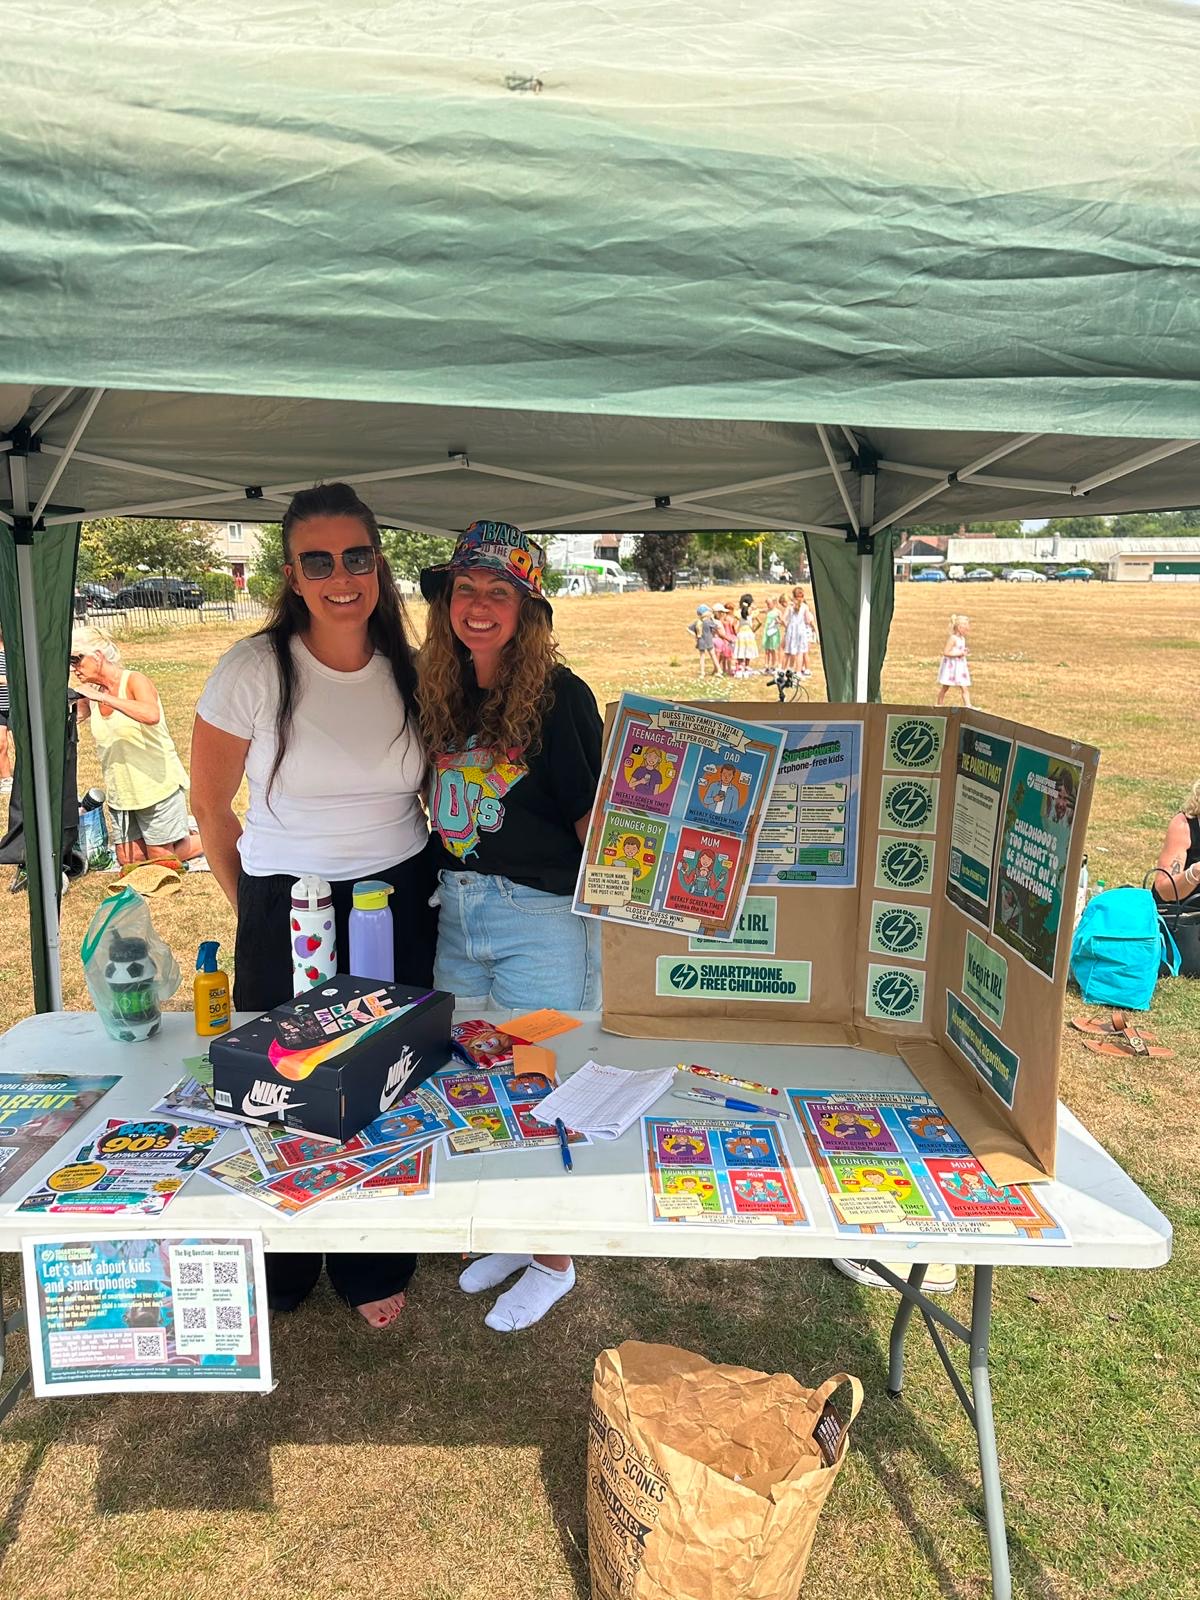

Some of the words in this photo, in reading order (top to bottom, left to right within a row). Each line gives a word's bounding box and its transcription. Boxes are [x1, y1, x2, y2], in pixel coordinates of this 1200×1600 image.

[483, 522, 530, 551] BACK
[493, 544, 508, 557] THE
[662, 711, 680, 720] GUESS
[682, 713, 696, 722] THIS
[696, 716, 722, 730] FAMILY'S
[723, 723, 740, 737] TOTAL
[668, 719, 693, 729] WEEKLY
[693, 723, 715, 735] SCREEN
[716, 730, 731, 741] TIME
[631, 727, 666, 745] TEENAGE
[687, 734, 697, 742] PER
[697, 736, 715, 747] GUESS
[890, 720, 934, 749] SMARTPHONE
[932, 730, 940, 752] FREE
[723, 751, 740, 763] DAD
[828, 754, 845, 765] kids
[892, 752, 935, 768] CHILDHOOD
[885, 781, 929, 809] SMARTPHONE
[610, 816, 646, 832] YOUNGER
[648, 822, 664, 834] BOY
[887, 812, 928, 828] CHILDHOOD
[700, 836, 721, 848] MUM
[1014, 818, 1058, 852] CHILDHOOD'S
[881, 841, 924, 868] SMARTPHONE
[921, 854, 929, 874] FREE
[1009, 832, 1023, 851] TOO
[1023, 840, 1048, 863] SHORT
[1049, 852, 1059, 870] TO
[1015, 851, 1038, 876] SPENT
[1038, 864, 1050, 882] ON
[1051, 872, 1057, 888] A
[883, 871, 925, 887] CHILDHOOD
[1006, 864, 1053, 904] SMARTPHONE
[625, 906, 649, 916] CLOSEST
[650, 911, 668, 920] GUESS
[669, 914, 684, 923] WINS
[648, 916, 658, 924] POT
[659, 919, 675, 927] PRIZE
[747, 914, 769, 932] IRL
[875, 909, 918, 934] SMARTPHONE
[877, 936, 919, 953] CHILDHOOD
[700, 964, 783, 981] SMARTPHONE
[968, 952, 984, 987] Keep
[990, 971, 1003, 1000] IRL
[700, 977, 727, 991] FREE
[728, 979, 797, 995] CHILDHOOD
[872, 971, 914, 998] SMARTPHONE
[912, 984, 920, 1003] FREE
[209, 1003, 221, 1014] 50
[874, 1000, 915, 1017] CHILDHOOD
[386, 1051, 414, 1092] NIKE
[19, 1082, 68, 1091] signed?
[250, 1079, 292, 1105] NIKE
[0, 1094, 78, 1109] ARENT
[118, 1123, 172, 1136] BACK
[101, 1135, 170, 1153] 90's
[834, 1158, 880, 1166] YOUNGER
[881, 1159, 901, 1167] BOY
[42, 1261, 70, 1278] Let's
[71, 1261, 93, 1276] talk
[95, 1260, 127, 1275] about
[129, 1258, 151, 1273] kids
[44, 1280, 65, 1293] and
[67, 1276, 137, 1294] smartphones
[602, 1452, 618, 1484] BUNS
[628, 1443, 671, 1483] MUFFINS
[622, 1457, 667, 1503] SCONES
